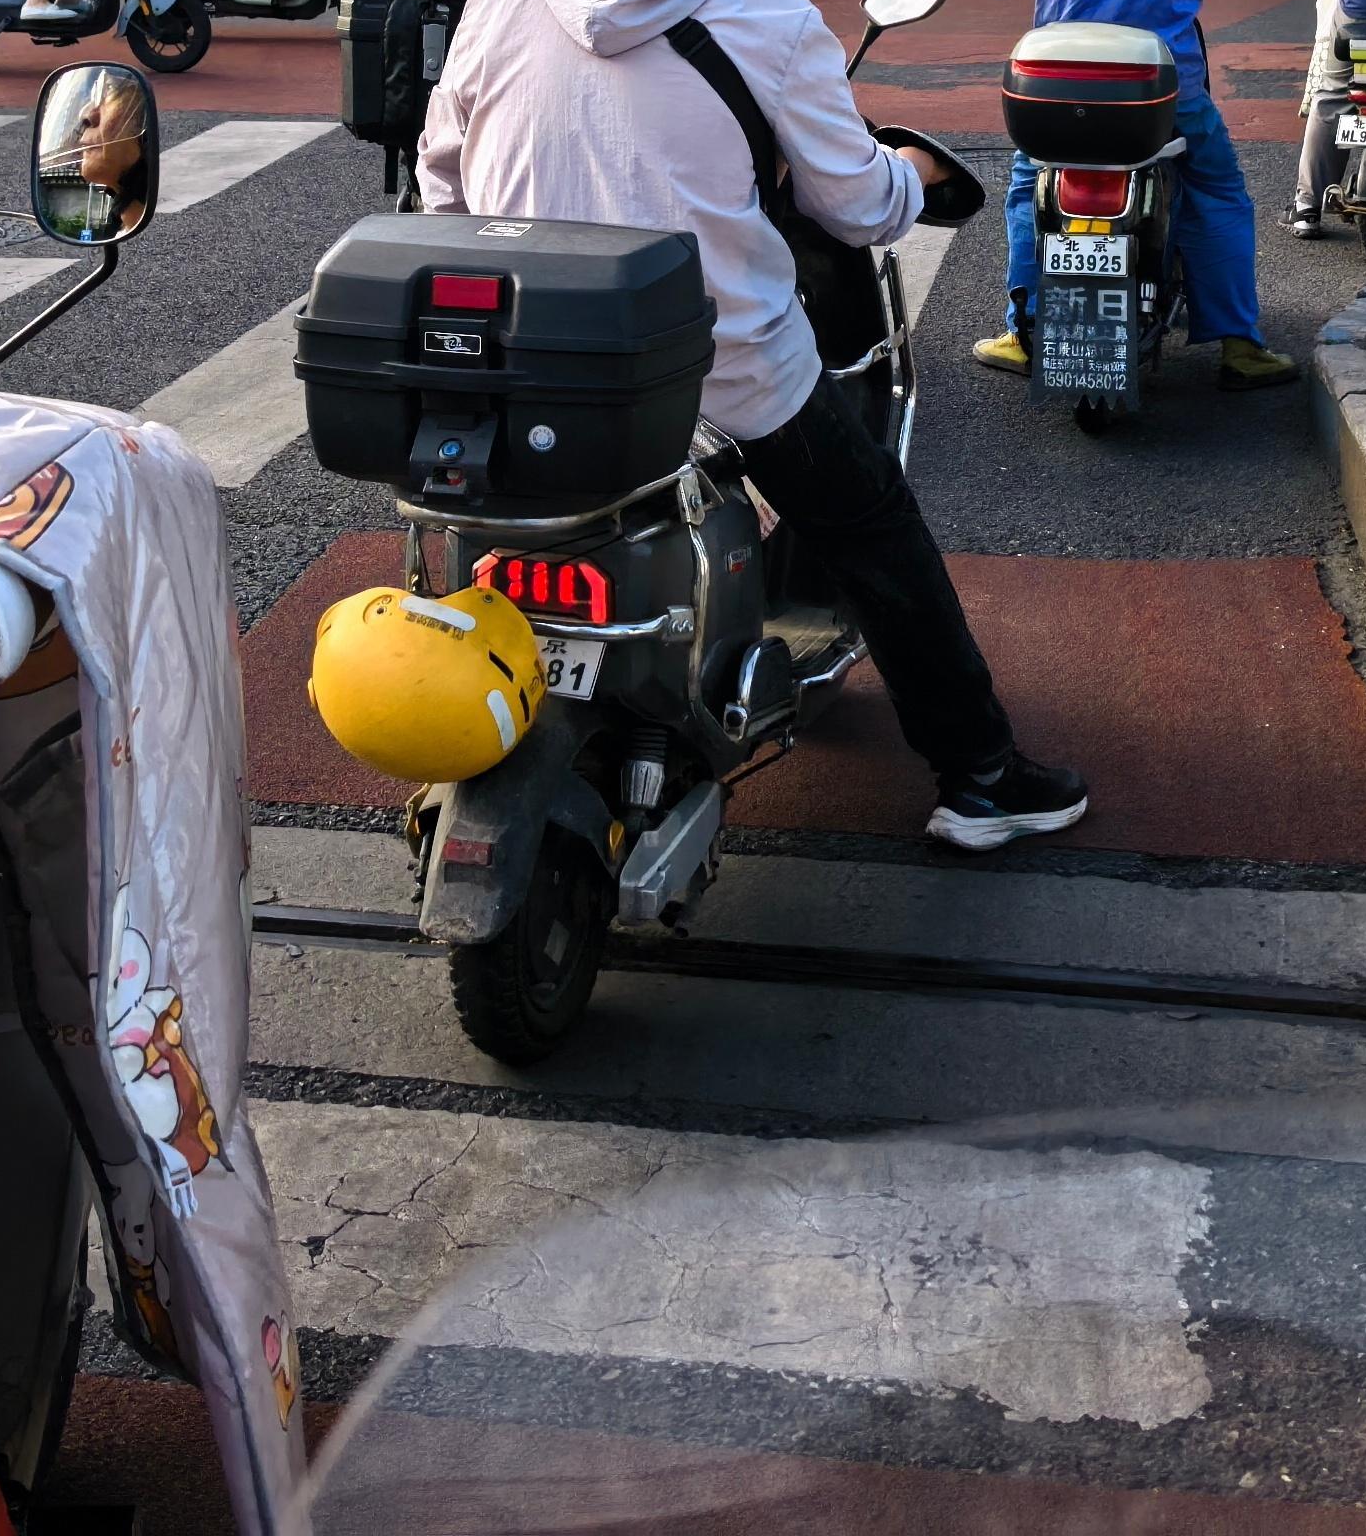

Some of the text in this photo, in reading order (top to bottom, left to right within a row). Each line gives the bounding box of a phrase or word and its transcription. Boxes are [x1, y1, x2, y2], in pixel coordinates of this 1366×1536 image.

[1065, 239, 1108, 253] 北京
[1050, 253, 1122, 272] 853925
[1043, 342, 1127, 359] 石景山总理
[1043, 371, 1127, 391] 15901458012
